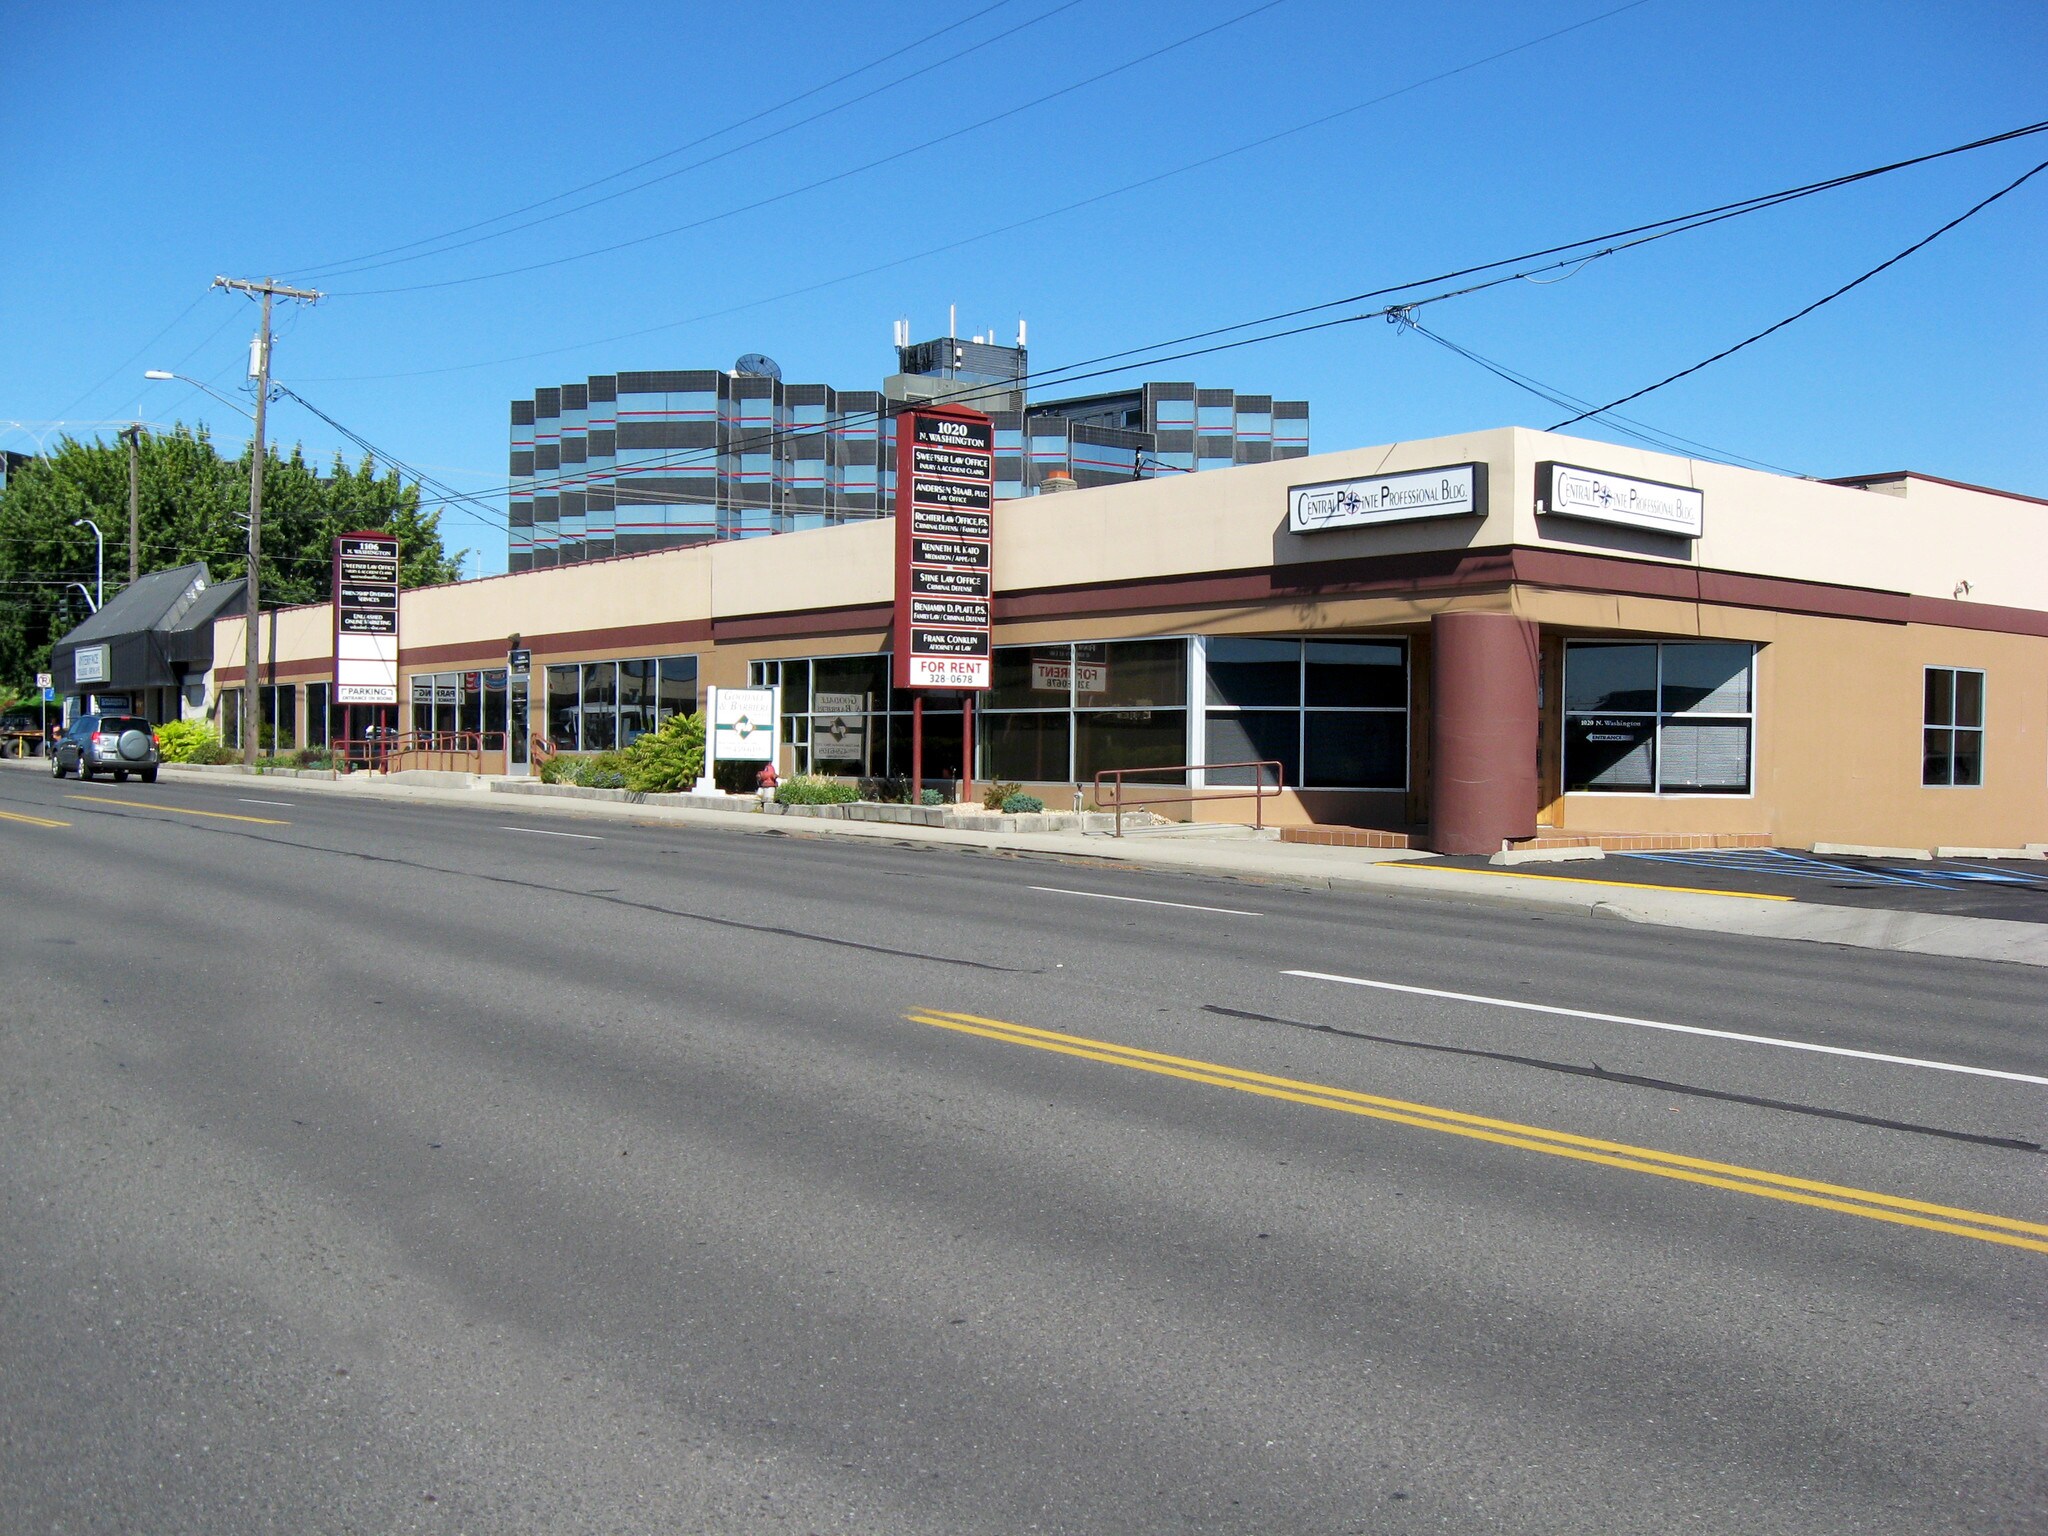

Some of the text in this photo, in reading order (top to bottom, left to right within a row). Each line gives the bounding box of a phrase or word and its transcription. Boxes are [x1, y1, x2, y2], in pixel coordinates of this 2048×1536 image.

[938, 422, 968, 436] 1020
[920, 432, 984, 447] N. WASHINGTON
[950, 455, 964, 465] LAW
[966, 457, 988, 468] OFFICE
[949, 495, 967, 503] OFFICE
[1558, 472, 1592, 507] CENTRAL
[1629, 488, 1674, 516] PROFESSIONAL
[1298, 492, 1337, 525] CENTRAL
[1380, 485, 1438, 507] PROFESSIONAL
[1442, 479, 1468, 500] BLDG.
[915, 512, 941, 522] RICHTER
[942, 514, 954, 523] LAW
[922, 543, 952, 552] KENNETH
[962, 546, 979, 555] KATO
[925, 553, 951, 561] MEDIATION
[920, 573, 980, 586] STINE LAW OFFICE
[927, 583, 972, 592] CRIMINAL DEFENSE
[914, 602, 946, 612] BENJAMIN
[923, 634, 977, 644] FRANK CONKLIN
[921, 662, 981, 673] FOR RENT
